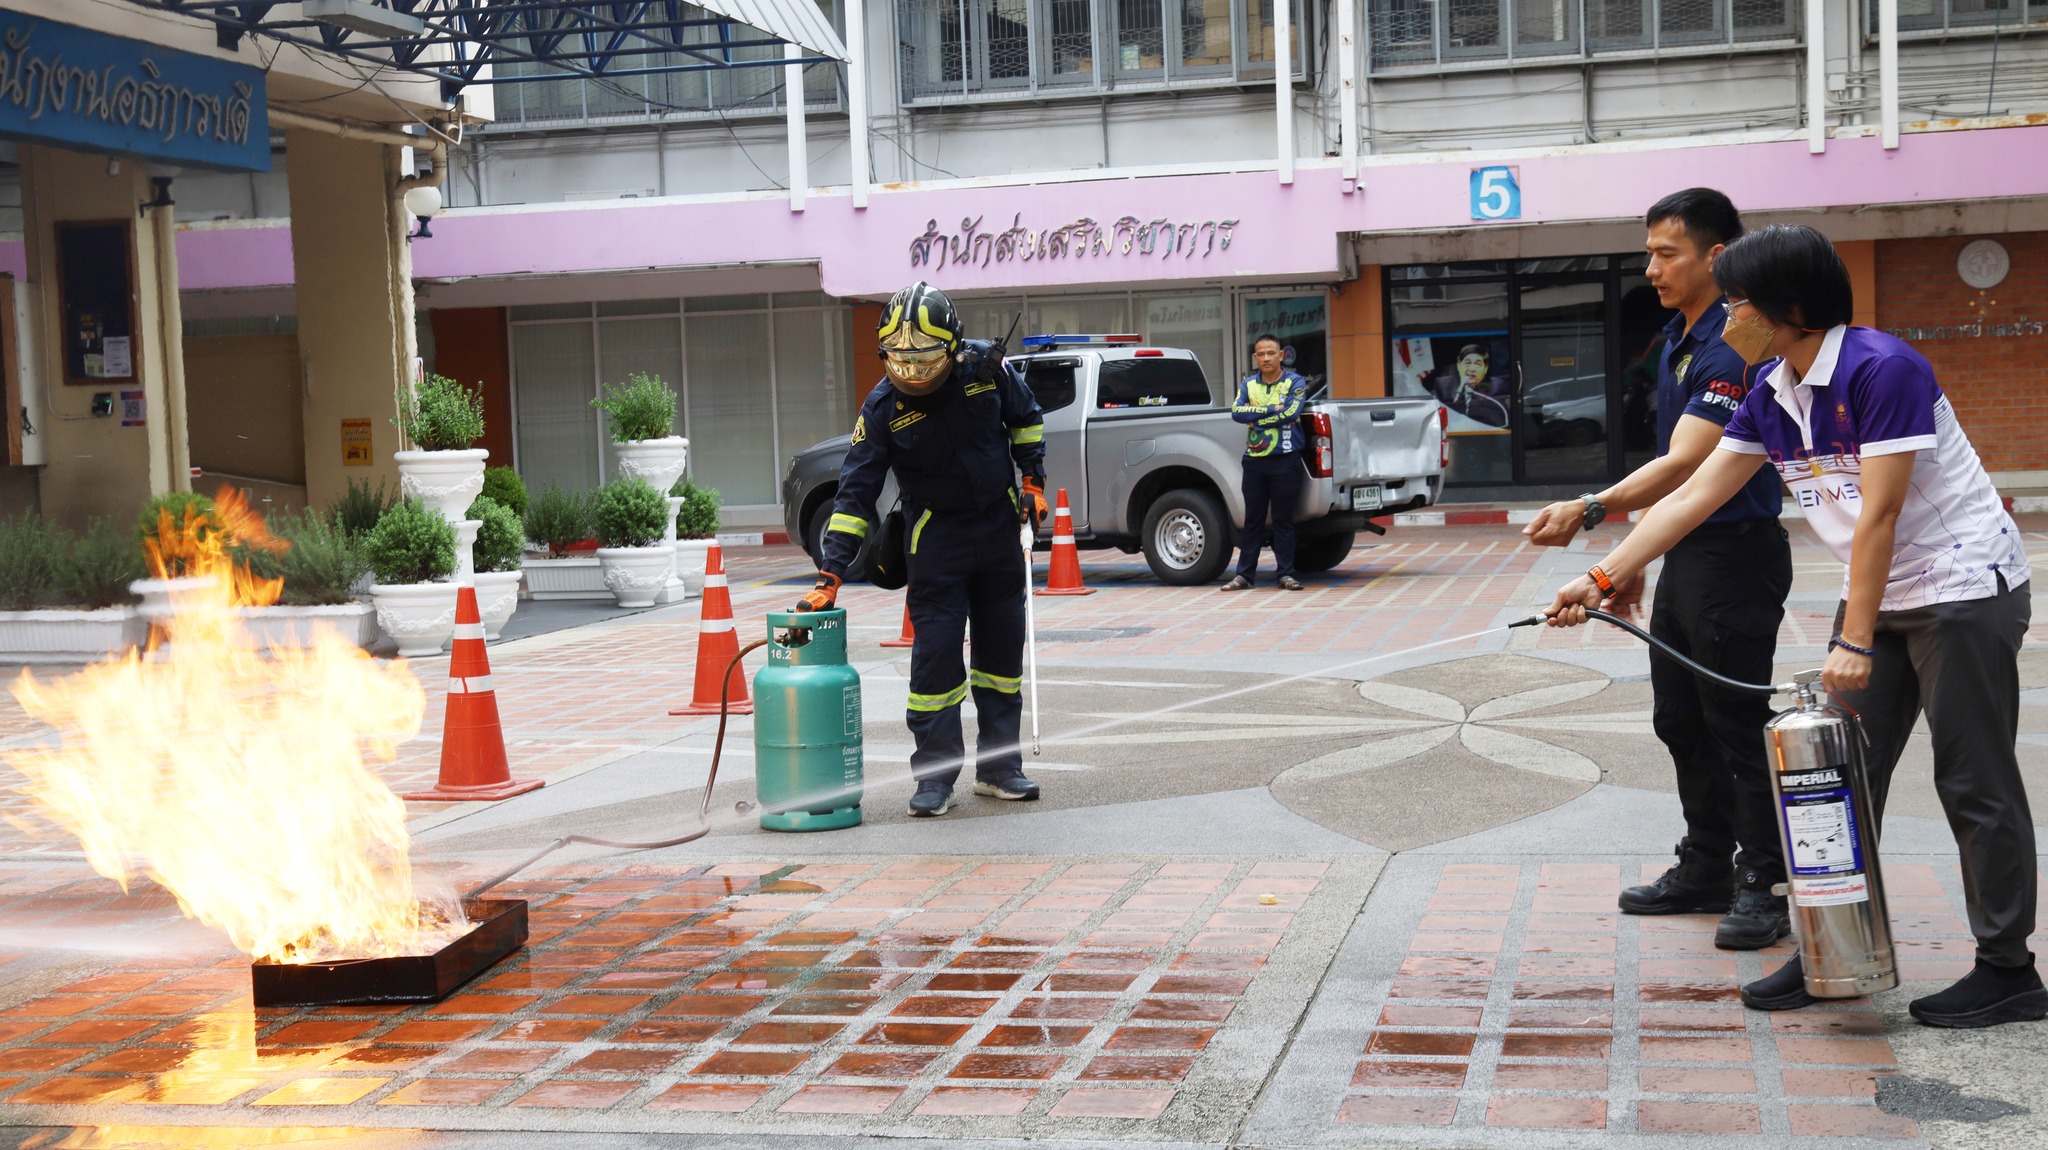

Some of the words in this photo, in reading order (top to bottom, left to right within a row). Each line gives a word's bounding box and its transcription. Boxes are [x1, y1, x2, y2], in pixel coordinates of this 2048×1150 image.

[1478, 170, 1511, 218] 5
[909, 211, 1240, 272] สำนักส่งเสริมวิชาการ
[1709, 380, 1743, 399] 199
[1702, 391, 1739, 411] BFRD
[770, 648, 792, 660] 16.2
[1780, 771, 1842, 786] IMPERIAL
